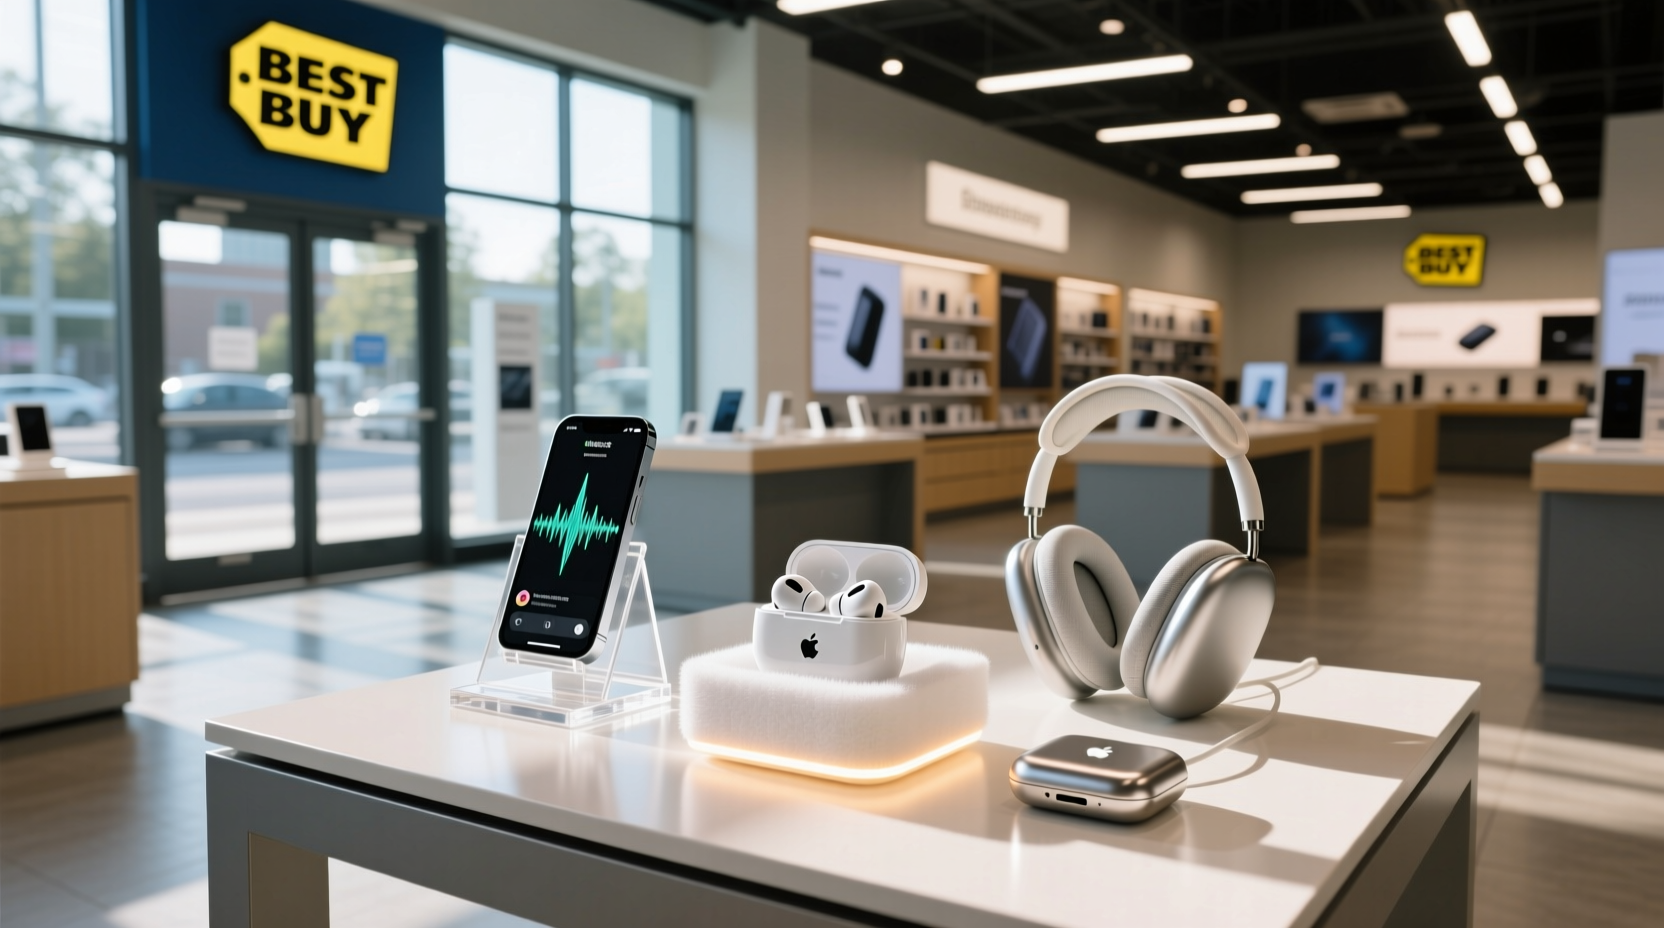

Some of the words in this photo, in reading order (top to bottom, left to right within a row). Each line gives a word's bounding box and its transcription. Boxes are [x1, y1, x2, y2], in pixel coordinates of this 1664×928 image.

[258, 45, 387, 106] BEST
[260, 90, 372, 144] BUY
[1419, 246, 1474, 259] BEST
[1419, 262, 1468, 274] BUY
